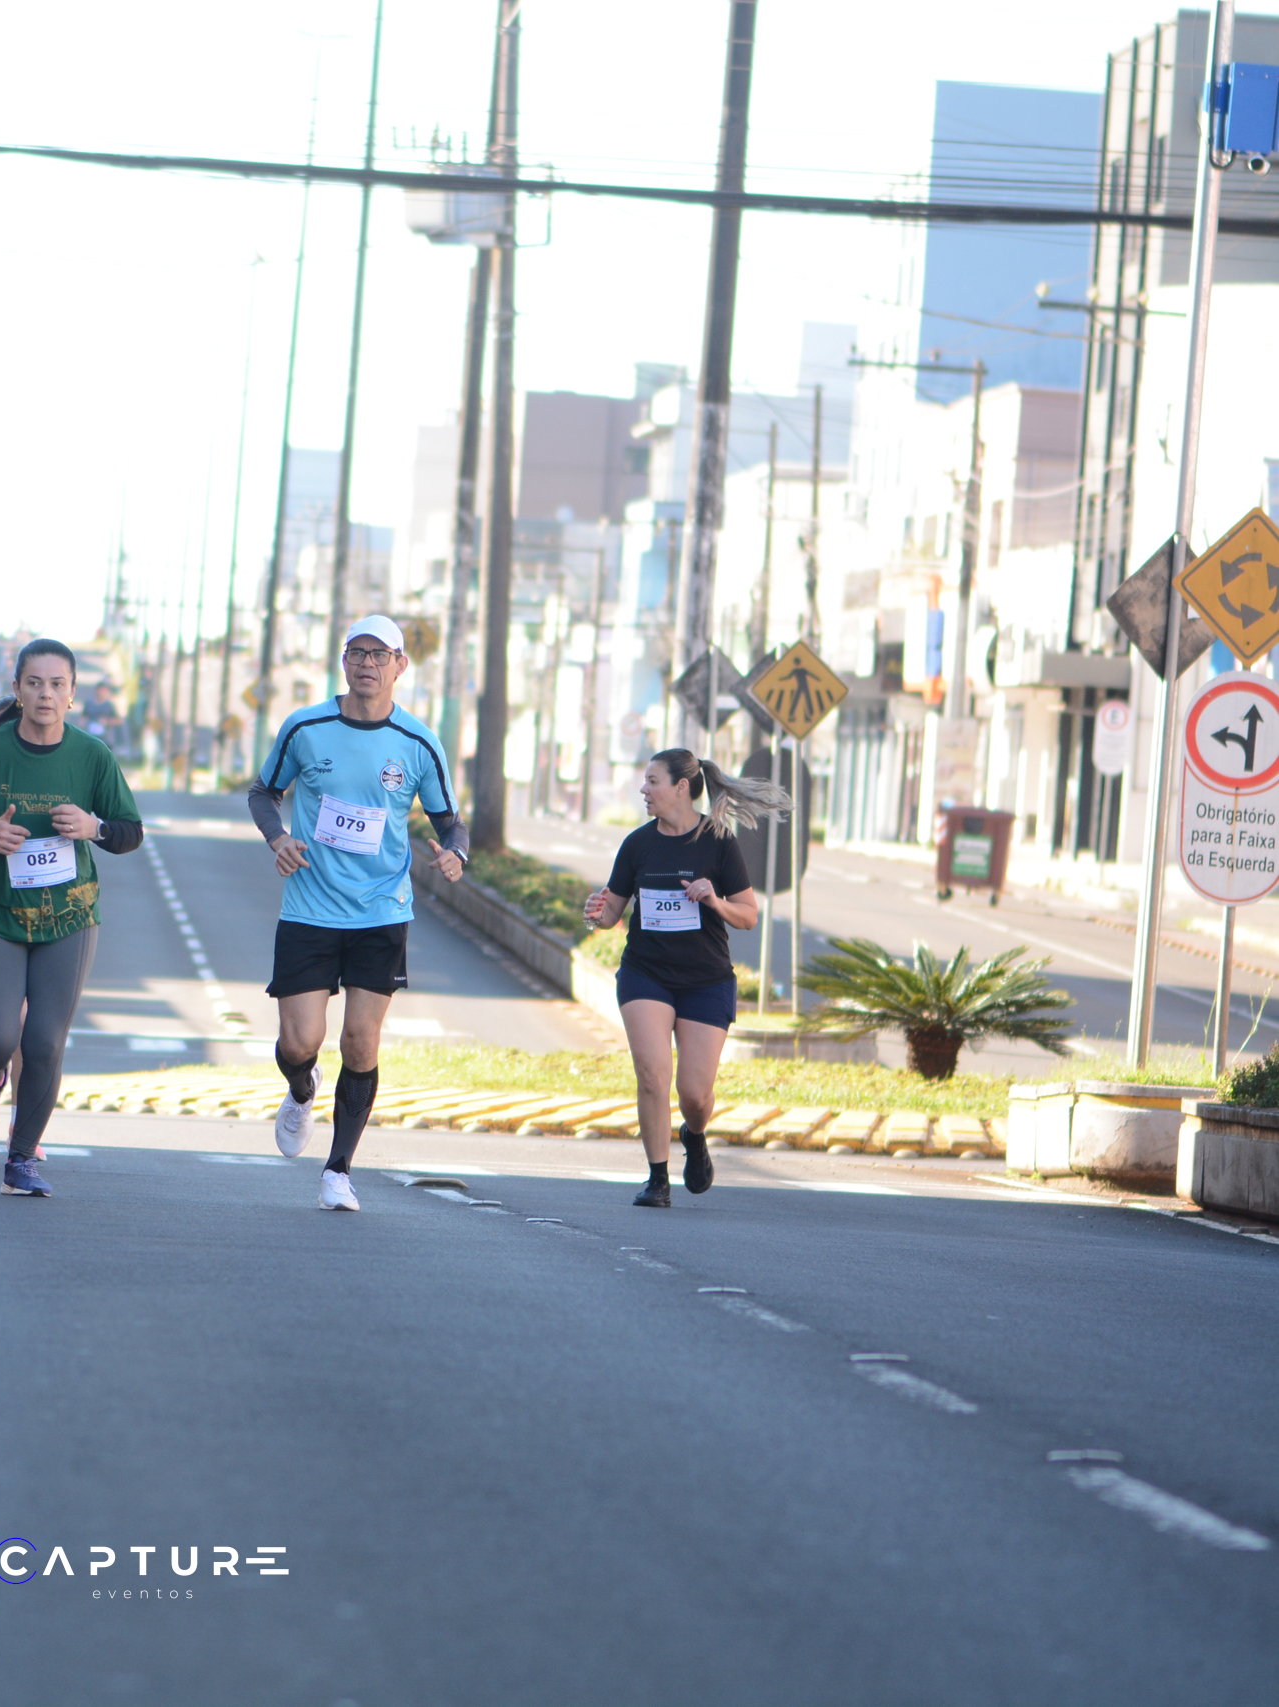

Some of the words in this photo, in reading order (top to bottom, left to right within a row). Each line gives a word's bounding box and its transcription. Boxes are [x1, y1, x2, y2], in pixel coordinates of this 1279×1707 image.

[1196, 802, 1276, 826] Obrigatório
[335, 815, 366, 832] 079
[1190, 829, 1222, 846] para
[1226, 832, 1234, 845] a
[1238, 830, 1276, 849] Faixa
[27, 851, 58, 866] 082
[1187, 849, 1204, 866] da
[1208, 851, 1275, 873] Esquerda
[655, 900, 681, 911] 205
